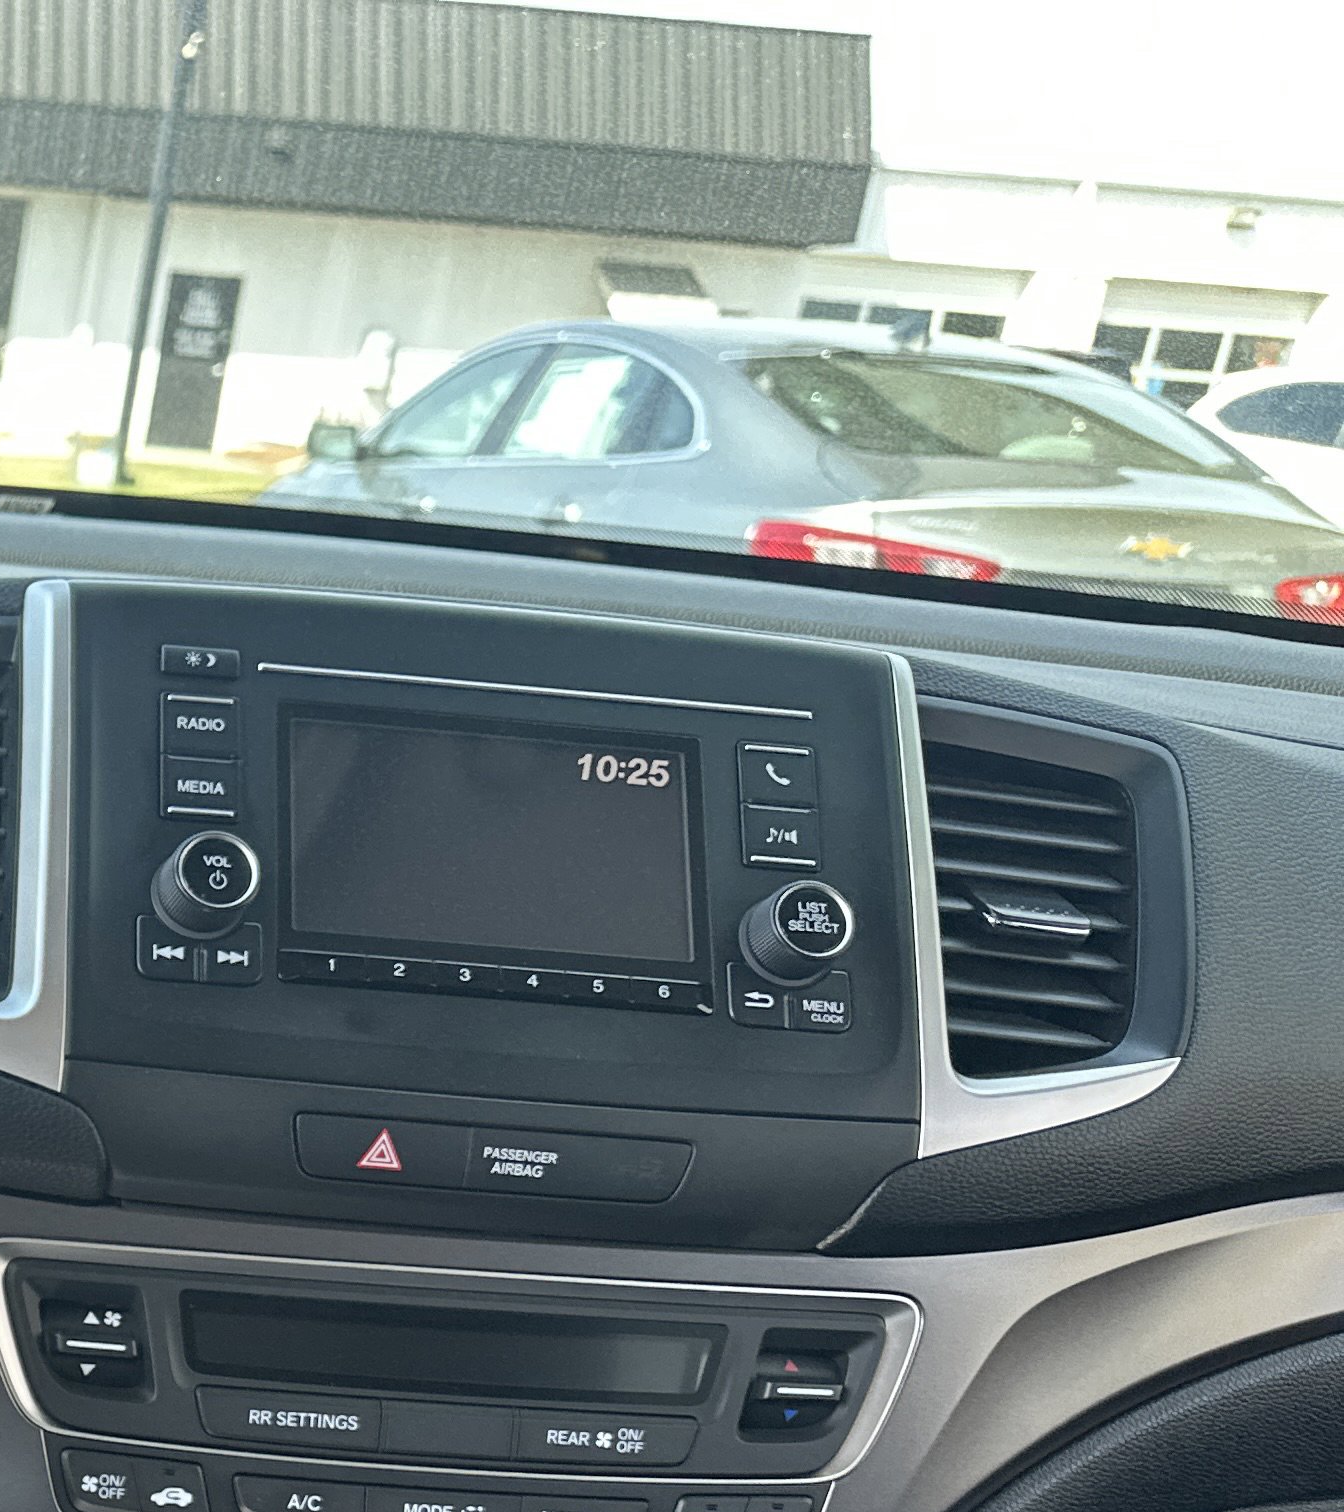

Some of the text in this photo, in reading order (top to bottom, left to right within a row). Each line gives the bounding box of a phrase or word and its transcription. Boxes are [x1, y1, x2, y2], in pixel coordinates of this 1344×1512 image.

[176, 716, 226, 732] RADIO
[577, 753, 670, 787] 10:25
[177, 779, 225, 796] MEDIA
[203, 855, 232, 868] VOL
[797, 901, 828, 914] LIST
[798, 912, 829, 922] PUSH
[787, 919, 840, 934] SELECT
[327, 957, 336, 972] 1
[393, 962, 407, 978] 2
[459, 967, 472, 983] 3
[526, 973, 539, 988] 4
[592, 979, 605, 994] 5
[657, 984, 671, 999] 6
[802, 999, 845, 1013] MENU
[810, 1013, 844, 1024] CLOCK
[483, 1146, 559, 1165] PASSENGER
[490, 1161, 544, 1178] AIRBAG
[248, 1408, 359, 1431] RR SETTINGS
[546, 1427, 645, 1447] REAR ON/
[616, 1440, 645, 1454] OFF
[99, 1473, 126, 1488] ON/
[98, 1487, 126, 1500] OFF
[286, 1493, 322, 1512] A/C
